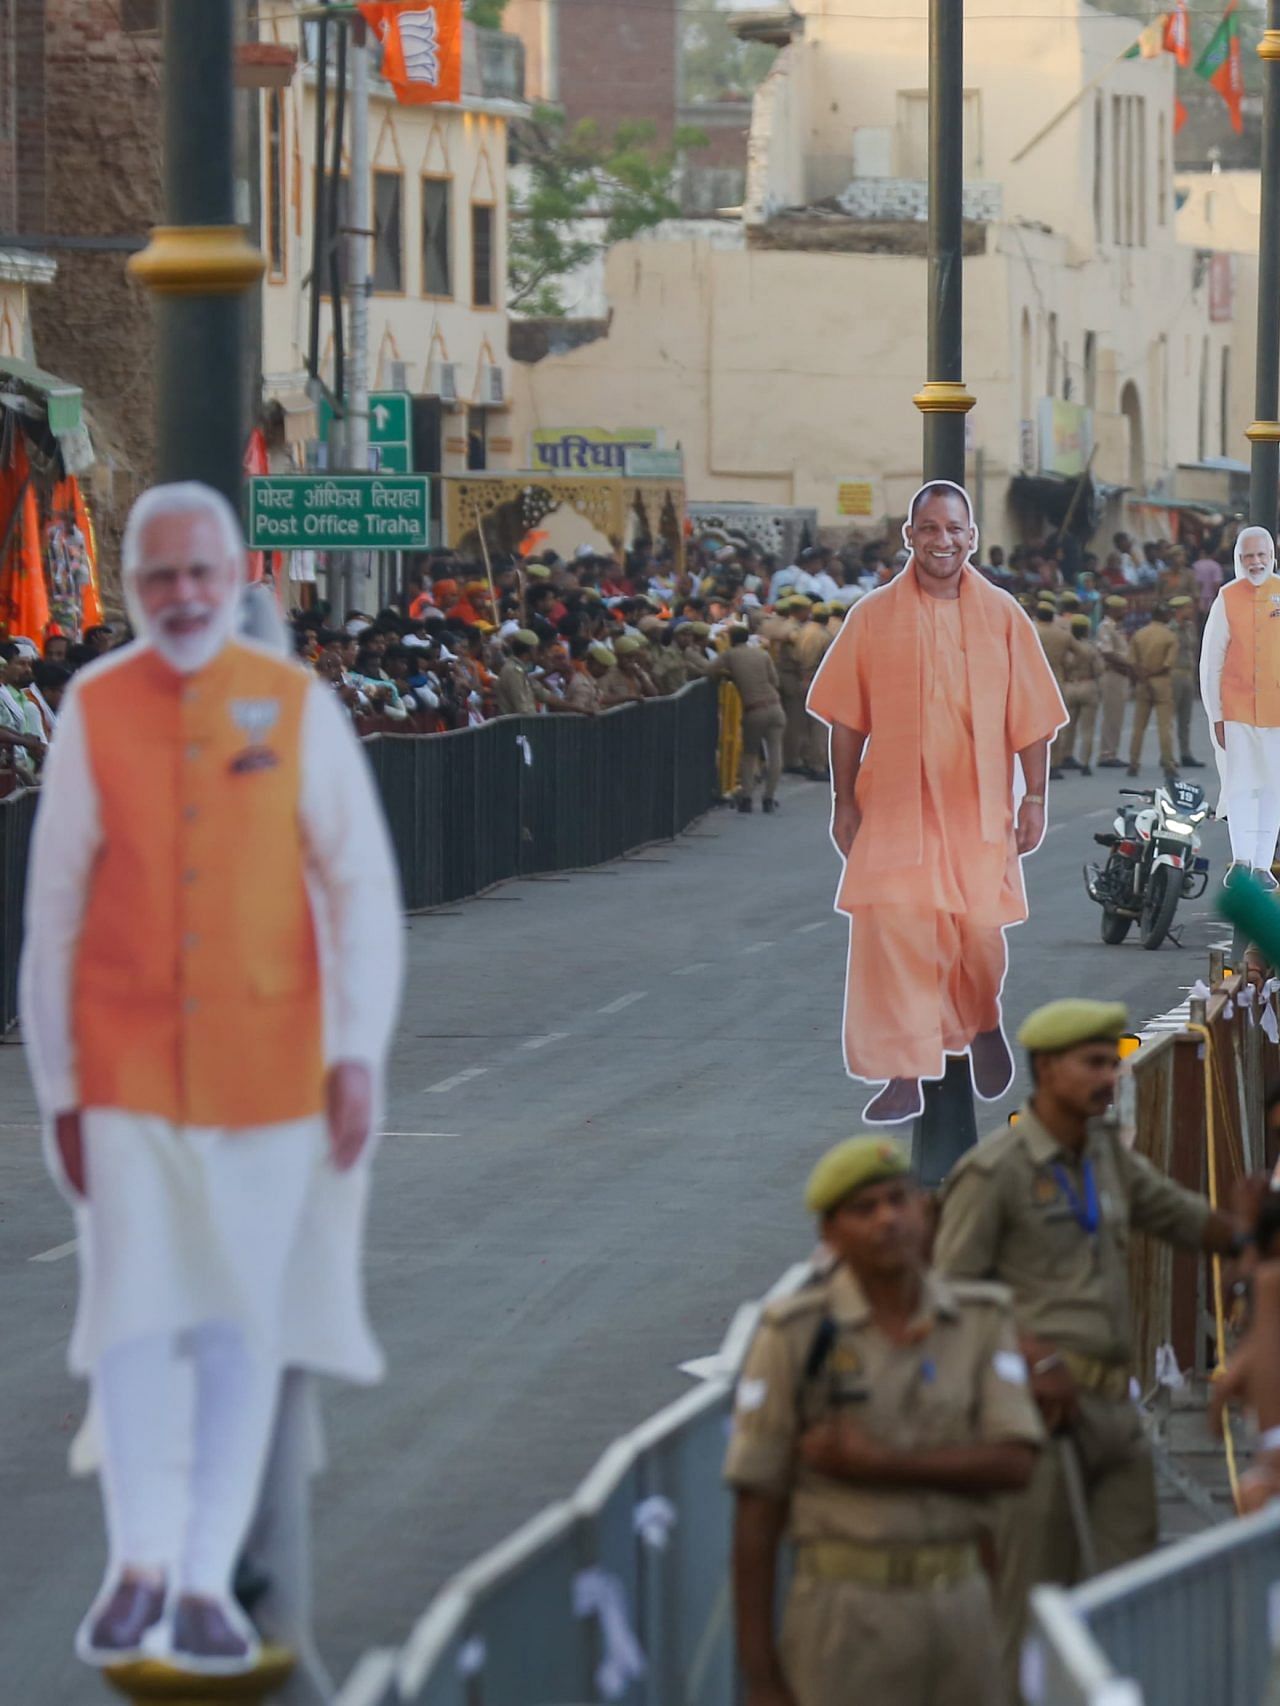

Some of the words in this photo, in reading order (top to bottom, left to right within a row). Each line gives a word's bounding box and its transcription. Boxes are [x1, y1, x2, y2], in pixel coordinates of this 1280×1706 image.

[256, 480, 294, 508] पोस्ट
[303, 481, 362, 508] ऑफिस
[370, 481, 421, 508] तिराहा
[256, 514, 297, 534] Post
[303, 514, 359, 534] Office
[364, 514, 420, 534] Tiraha
